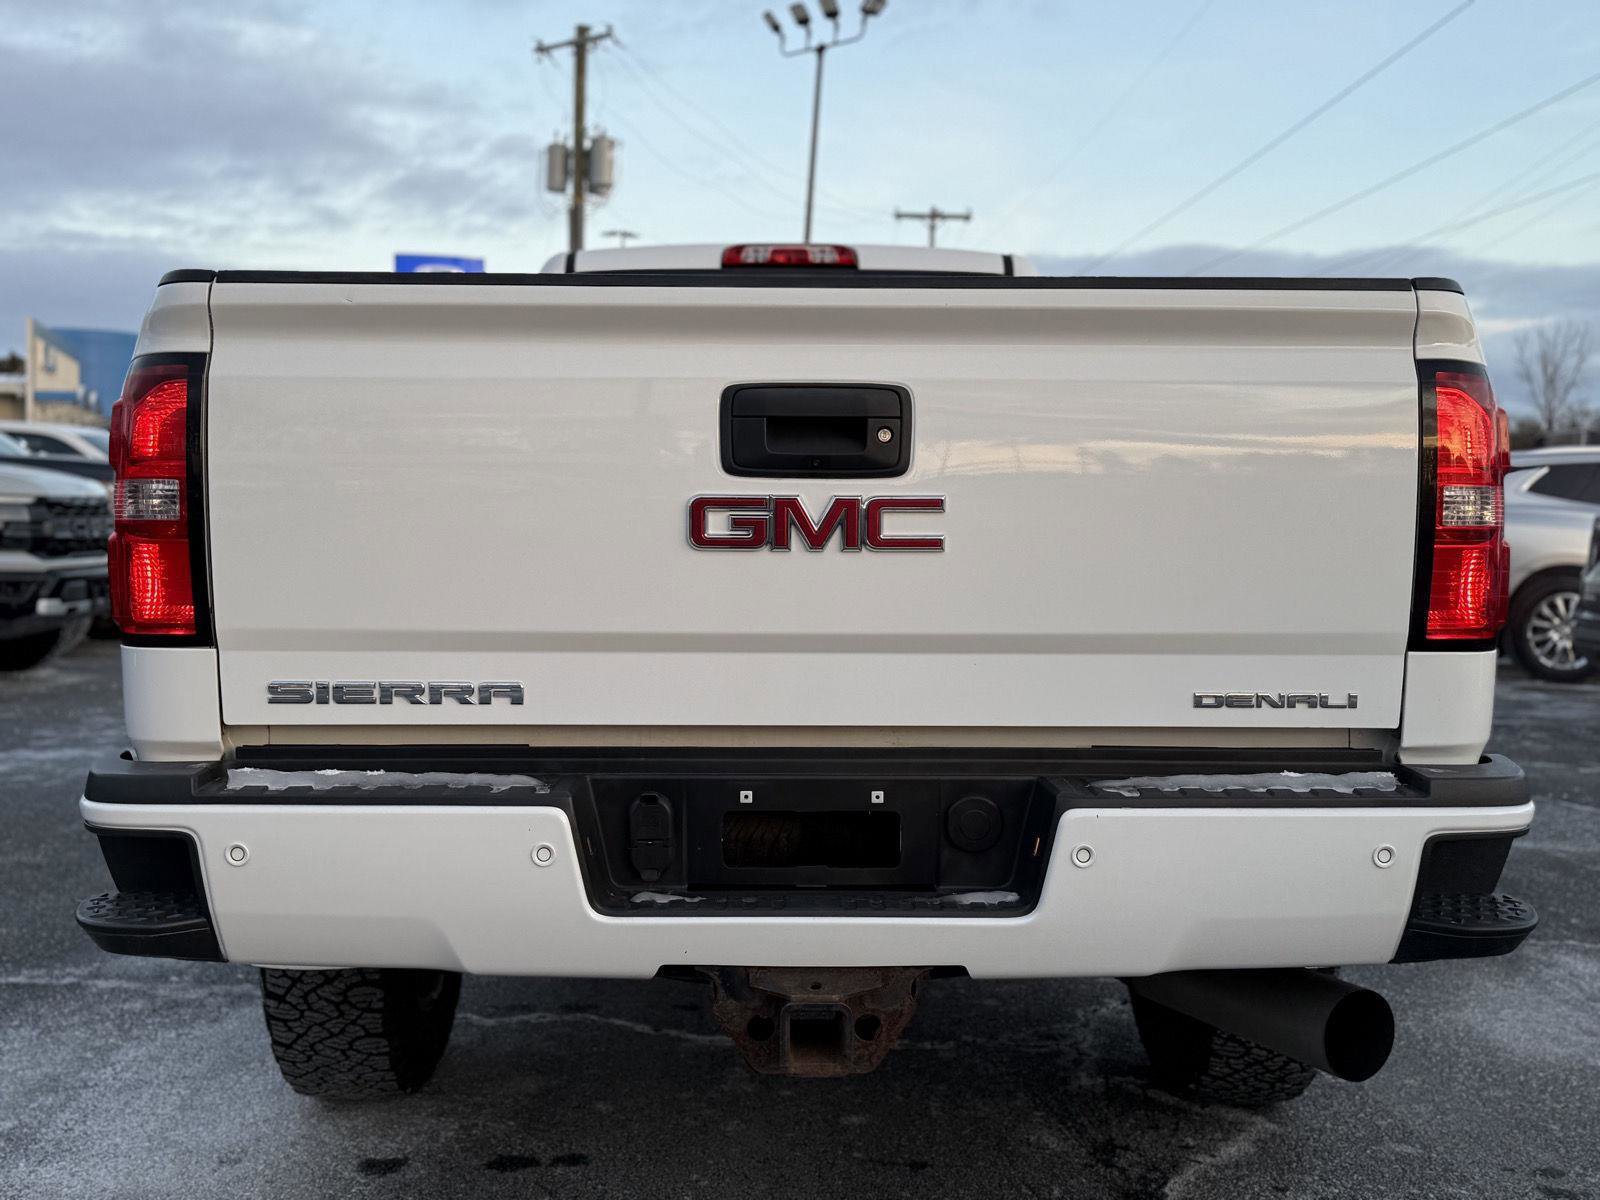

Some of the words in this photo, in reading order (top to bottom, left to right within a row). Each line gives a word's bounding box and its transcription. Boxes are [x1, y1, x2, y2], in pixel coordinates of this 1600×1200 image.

[687, 494, 946, 552] GMC
[267, 681, 525, 705] SIERRA
[1193, 692, 1358, 709] DENALI
